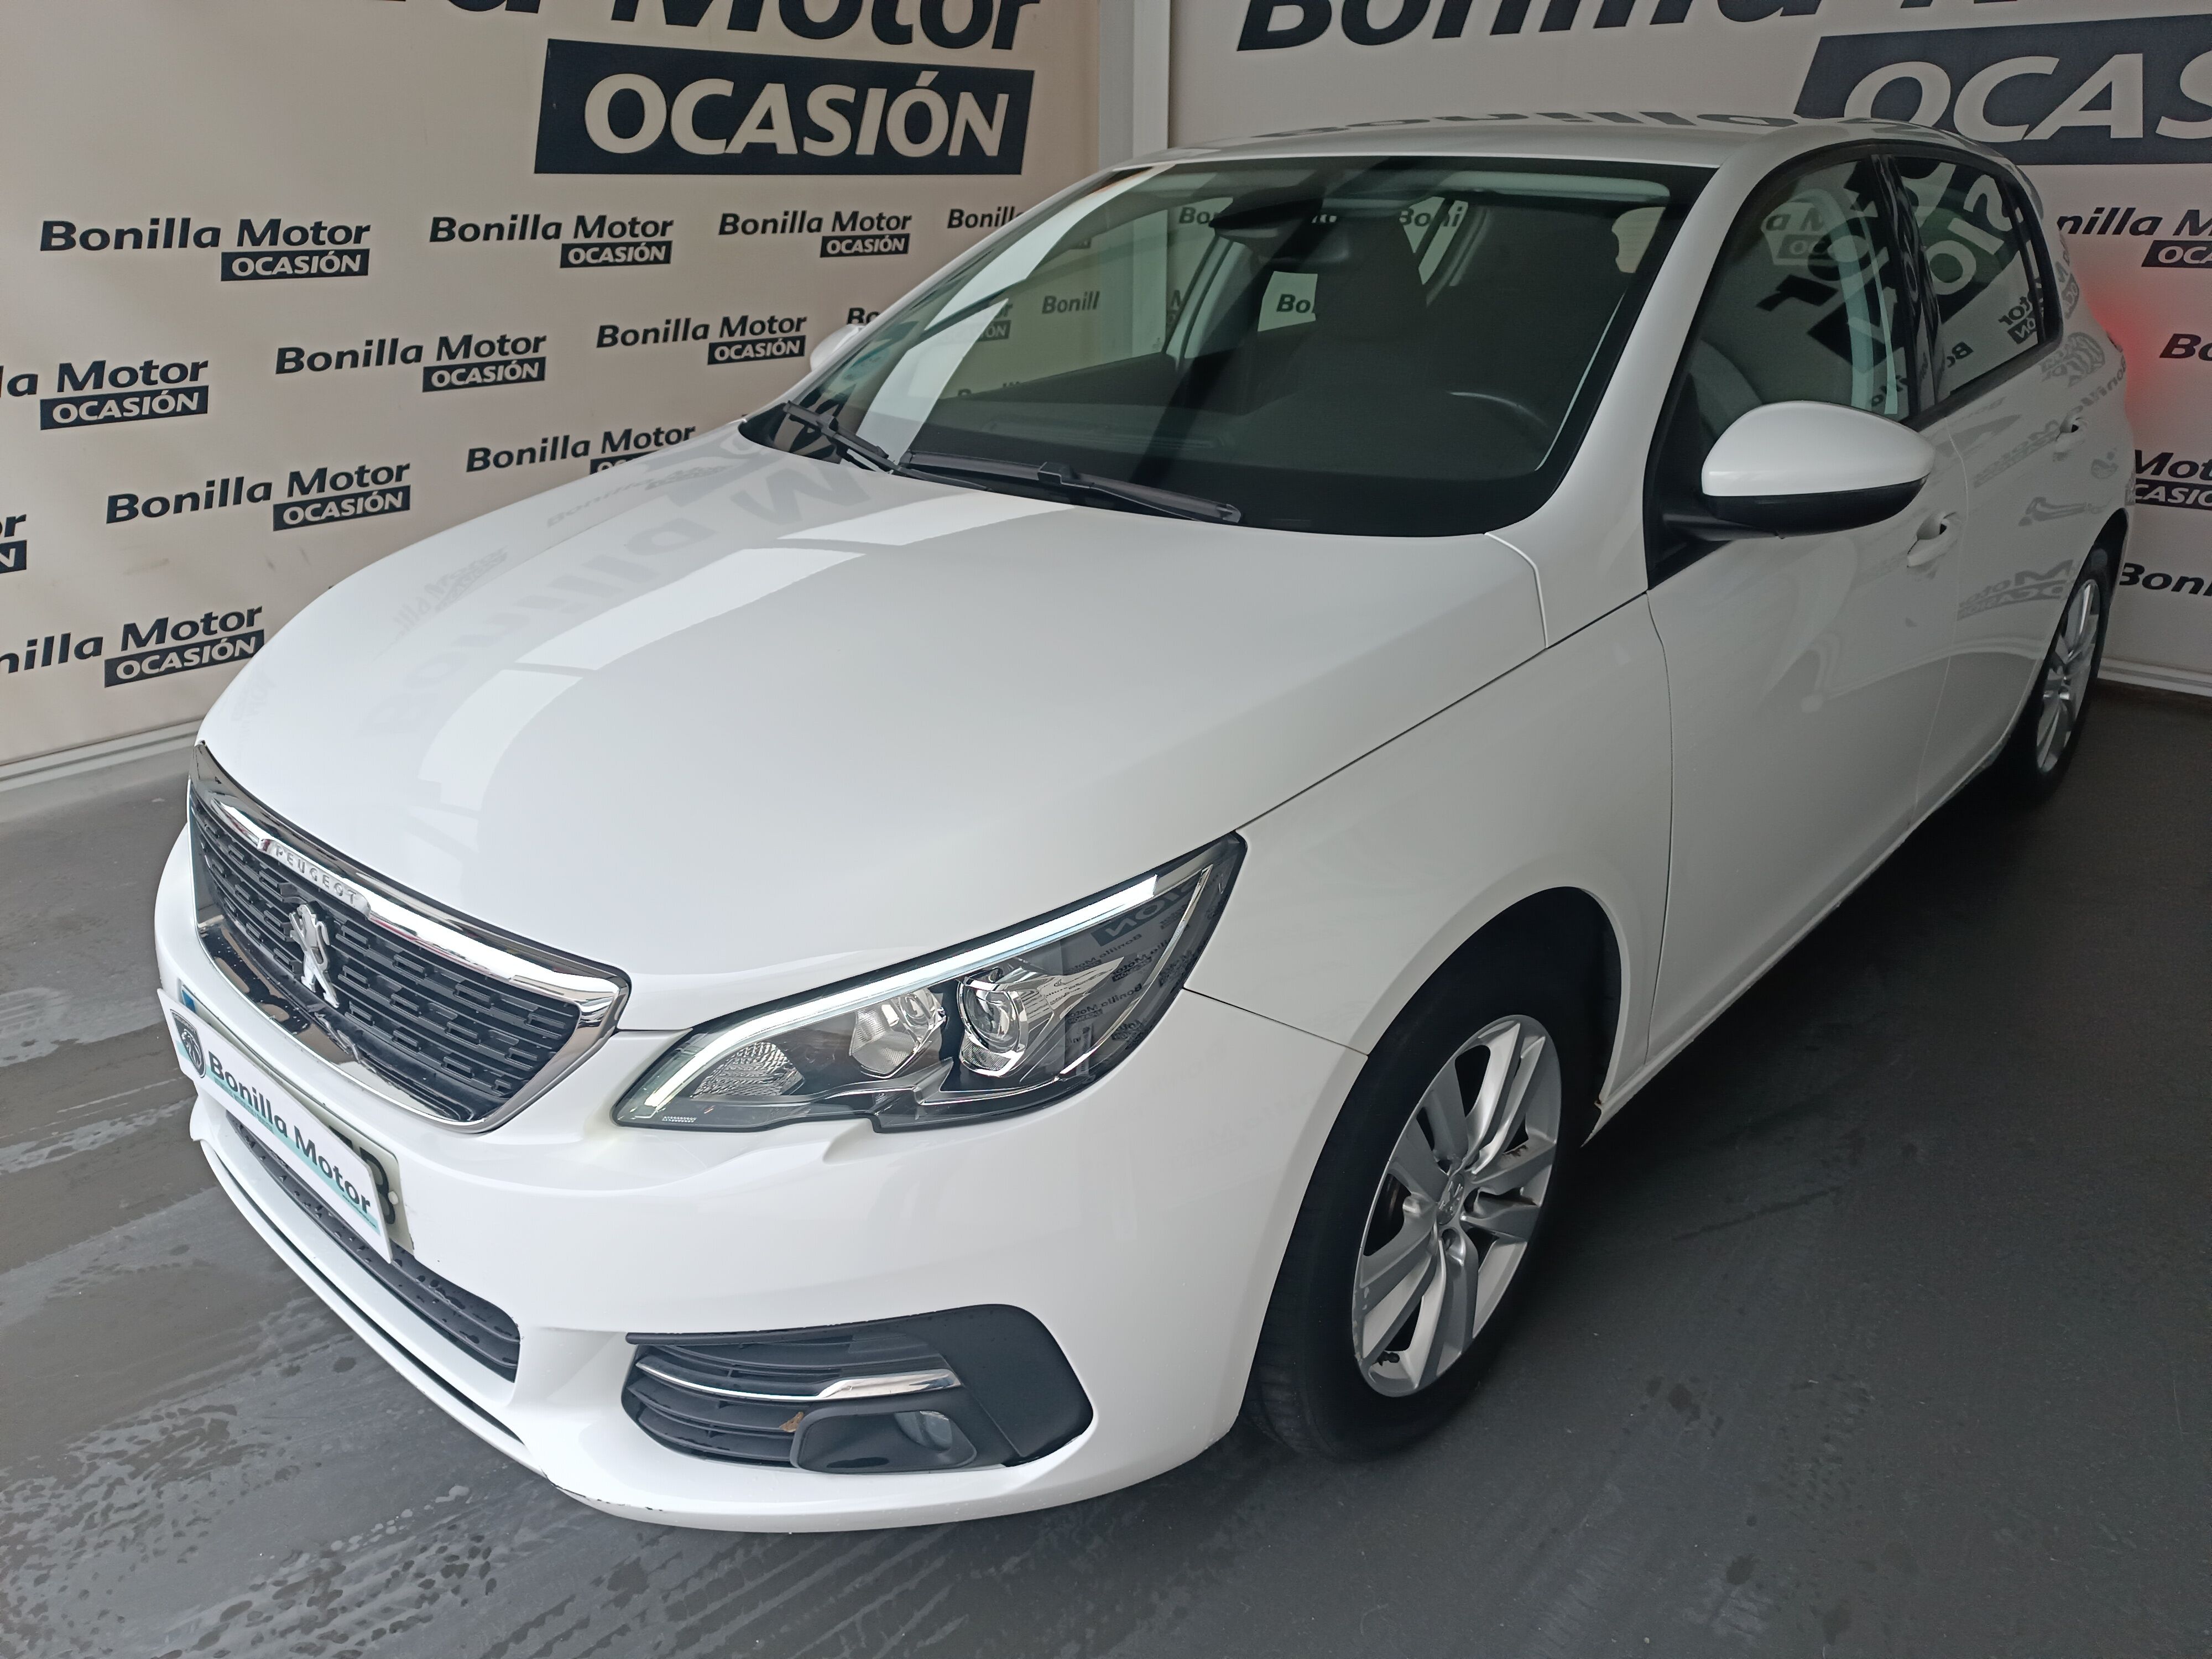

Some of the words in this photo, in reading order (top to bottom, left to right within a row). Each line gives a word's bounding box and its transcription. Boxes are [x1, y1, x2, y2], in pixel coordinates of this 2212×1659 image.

[585, 71, 1009, 157] OCASIÓN
[40, 218, 221, 251] Bonilla
[237, 218, 371, 247] Motor
[430, 214, 562, 242] Bonilla
[573, 215, 674, 238] Motor
[719, 211, 823, 235] Bonilla
[832, 211, 912, 232] Motor
[568, 242, 666, 264] OCASIÓN
[827, 235, 905, 254] OCASIÓN
[232, 252, 361, 276] OCASIÓN
[596, 318, 708, 348] Bonilla
[719, 315, 807, 338] Motor
[275, 338, 423, 374] Bonilla
[436, 335, 546, 361] Motor
[714, 338, 800, 361] OCASIÓN
[58, 360, 208, 393] Motor
[432, 361, 539, 387] OCASIÓN
[53, 390, 199, 424] OCASIÓN
[466, 435, 589, 472] Bonilla
[602, 426, 696, 453] Motor
[106, 478, 272, 524] Bonilla
[288, 463, 411, 497] Motor
[283, 491, 403, 525] OCASIÓN
[121, 606, 262, 651] Motor
[117, 638, 256, 680] OCASIÓN
[276, 845, 357, 905] PEUGEOT
[208, 1050, 288, 1138] Bonilla
[294, 1125, 371, 1214] Motor
